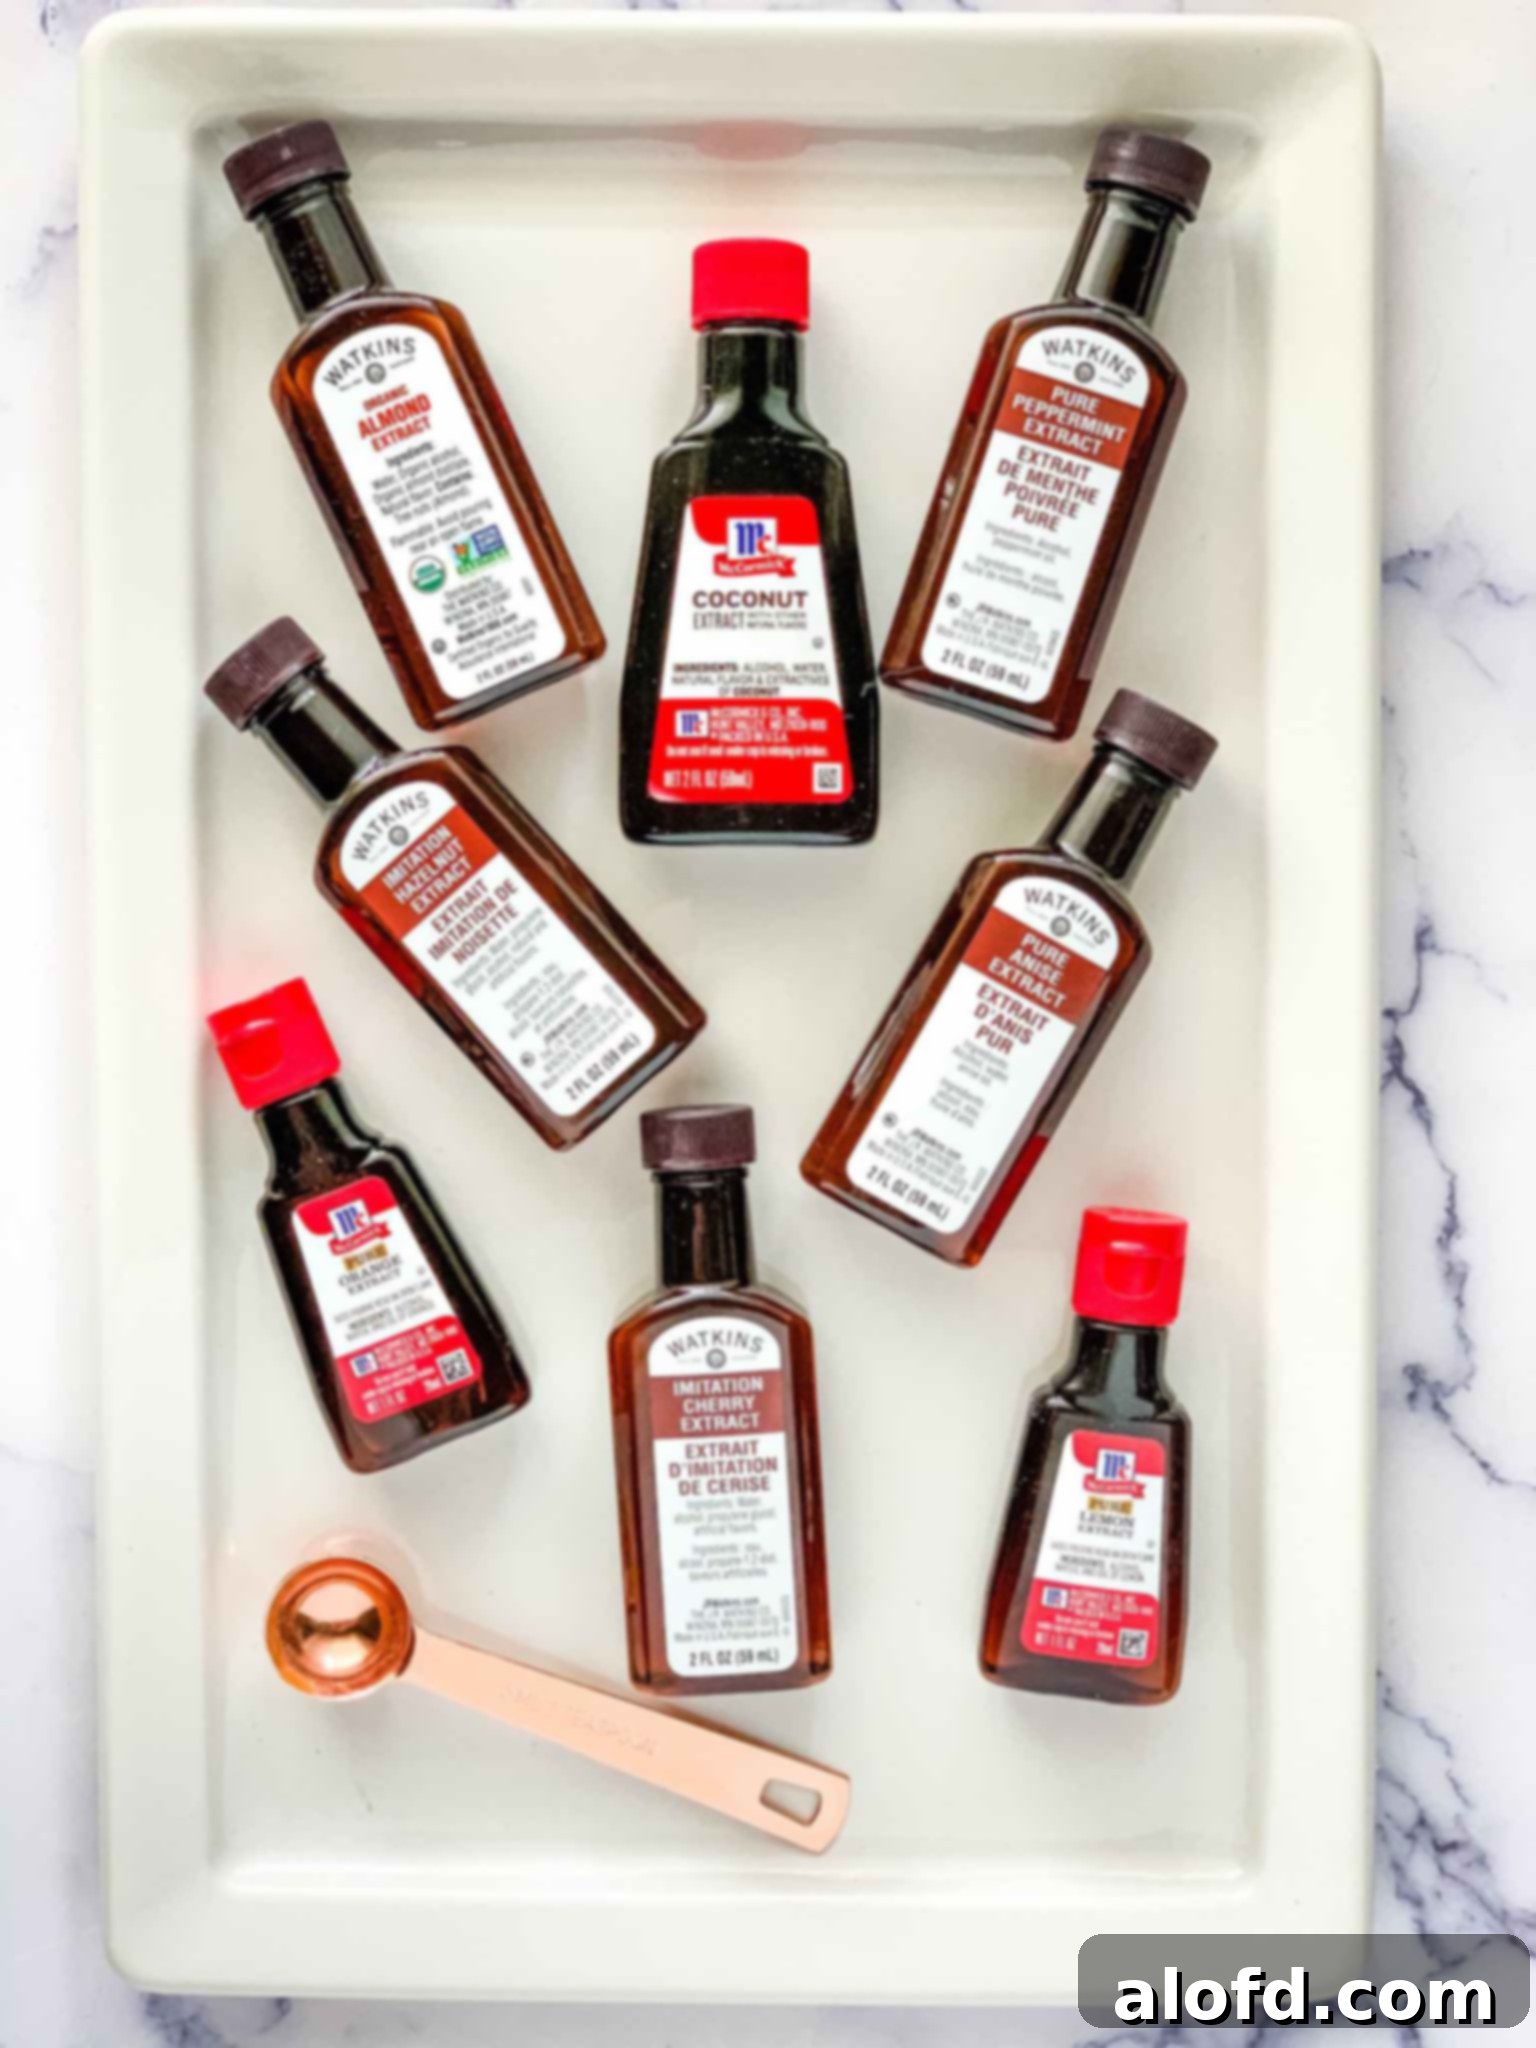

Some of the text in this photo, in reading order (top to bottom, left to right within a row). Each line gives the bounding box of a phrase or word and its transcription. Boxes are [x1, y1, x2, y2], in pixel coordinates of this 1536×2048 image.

[322, 334, 415, 385] WATKINS
[1042, 338, 1136, 382] WATKINS
[355, 391, 433, 438] ALMOND
[361, 382, 410, 412] ORGANIC
[1050, 385, 1100, 414] PURE
[370, 415, 432, 452] EXTRACT
[1010, 392, 1126, 443] PEPPERMINT
[1022, 416, 1103, 455] EXTRACT
[996, 458, 1099, 505] DE MENTHE
[1016, 445, 1091, 482] EXTRAIT
[1011, 503, 1061, 532] PURE
[692, 590, 807, 607] COCONUT
[693, 612, 744, 629] EXTRACT
[672, 675, 713, 685] NATURAL
[940, 647, 951, 664] 2
[951, 651, 966, 669] FL
[967, 656, 986, 675] OZ
[1006, 669, 1031, 690] mL)
[351, 790, 427, 859] WATKINS
[380, 823, 453, 889] IMITATION
[391, 836, 466, 904] HAZELNUT
[408, 855, 473, 914] EXTRACT
[426, 877, 518, 961] IMITATION DE
[429, 878, 490, 933] EXTRAIT
[1025, 887, 1110, 943] WATKINS
[451, 902, 519, 964] NOISETTE
[1019, 931, 1070, 969] PURE
[986, 955, 1067, 1010] EXTRACT
[1008, 947, 1063, 986] ANISE
[972, 1001, 1035, 1045] D'ANIS
[976, 982, 1050, 1033] EXTRAIT
[974, 1023, 1015, 1056] PUR
[563, 1085, 578, 1101] 2
[571, 1074, 591, 1094] FL
[584, 1061, 605, 1083] OZ
[614, 1030, 642, 1056] mL)
[864, 1163, 879, 1181] 2
[874, 1169, 893, 1189] FL
[889, 1177, 910, 1198] OZ
[924, 1197, 951, 1222] mL)
[337, 1254, 402, 1287] ORANGE
[665, 1329, 764, 1356] WATKINS
[673, 1376, 764, 1395] IMITATION
[682, 1395, 755, 1413] CHERRY
[680, 1412, 760, 1432] EXTRACT
[668, 1456, 778, 1477] D'IMITATION
[685, 1440, 759, 1459] EXTRAIT
[678, 1475, 770, 1496] DE CERISE
[1079, 1511, 1135, 1527] LEMON
[689, 1647, 779, 1667] 2 FL OZ (59 mL)
